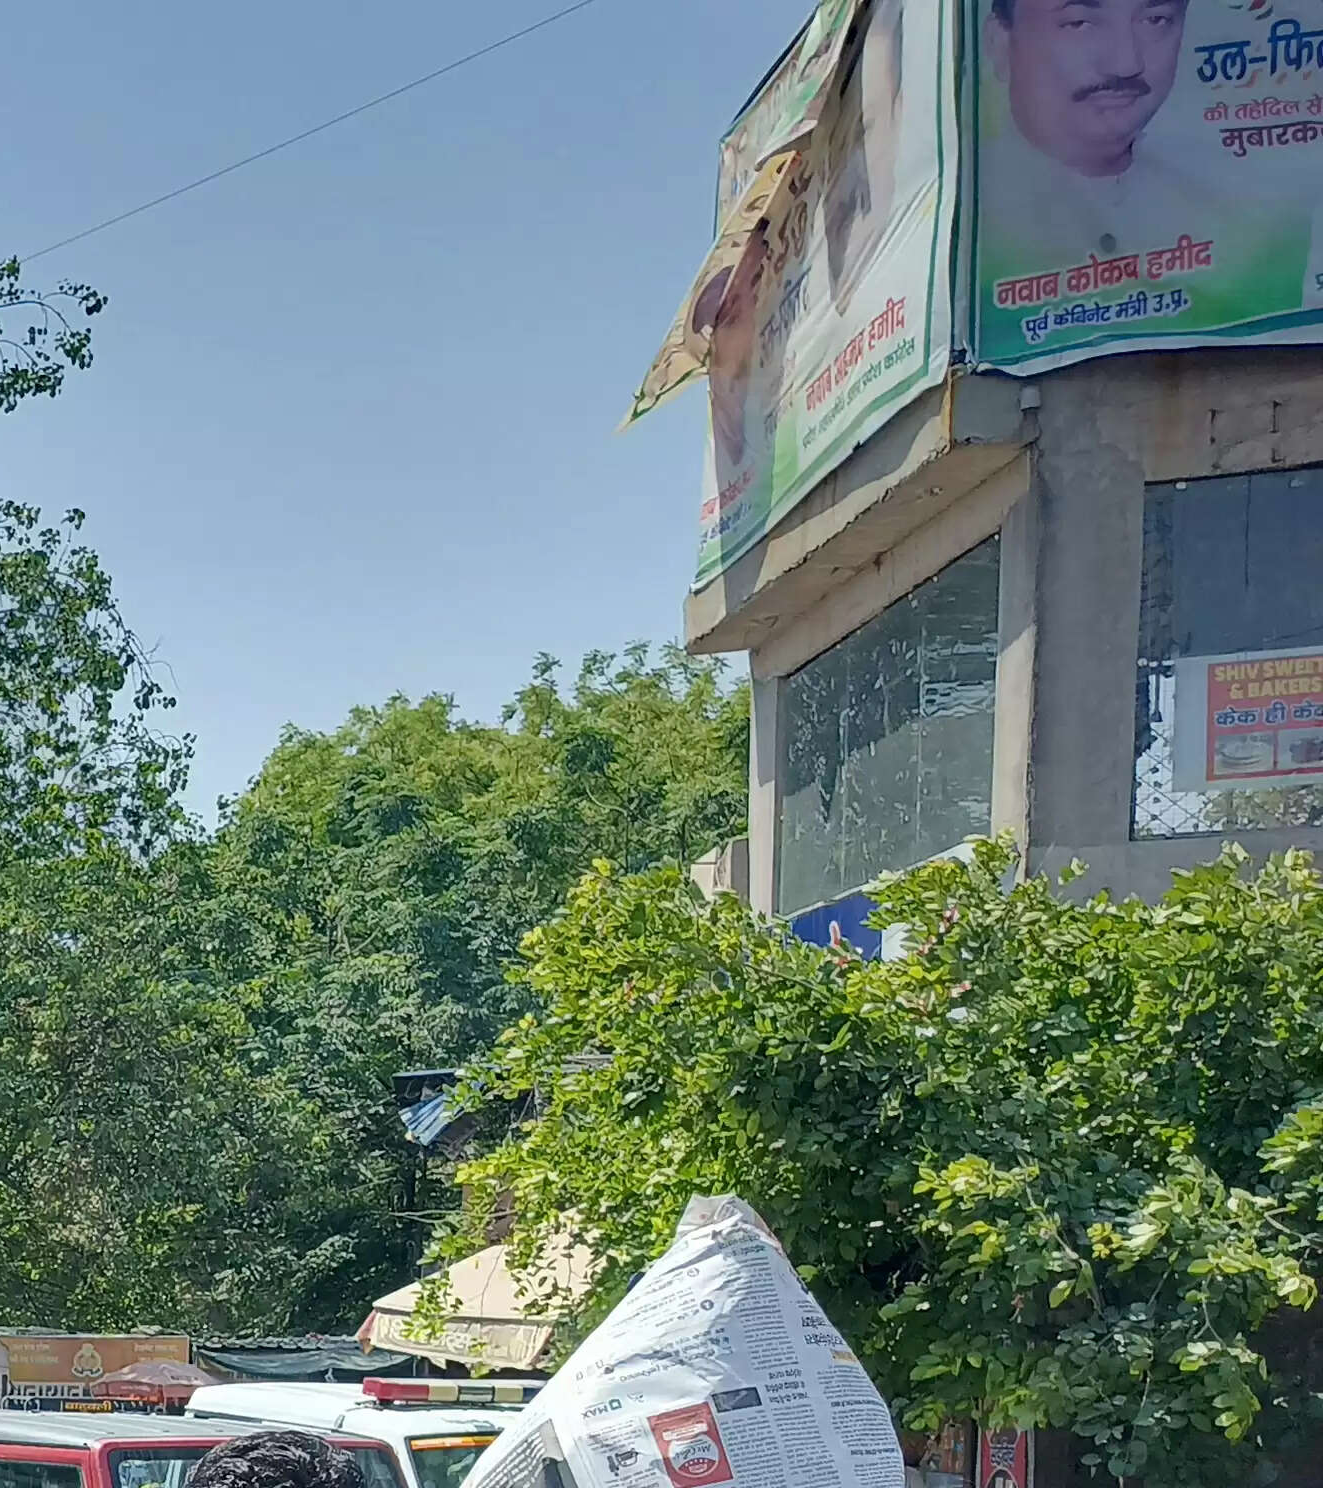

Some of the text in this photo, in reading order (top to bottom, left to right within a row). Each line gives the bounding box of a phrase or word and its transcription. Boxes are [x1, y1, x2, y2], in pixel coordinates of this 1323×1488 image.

[1219, 120, 1323, 157] मुबारक
[997, 235, 1213, 306] नवाब कोकब हमीद
[1214, 664, 1262, 682] SHIV
[1248, 676, 1323, 698] BAKERS
[1215, 706, 1259, 727] केक
